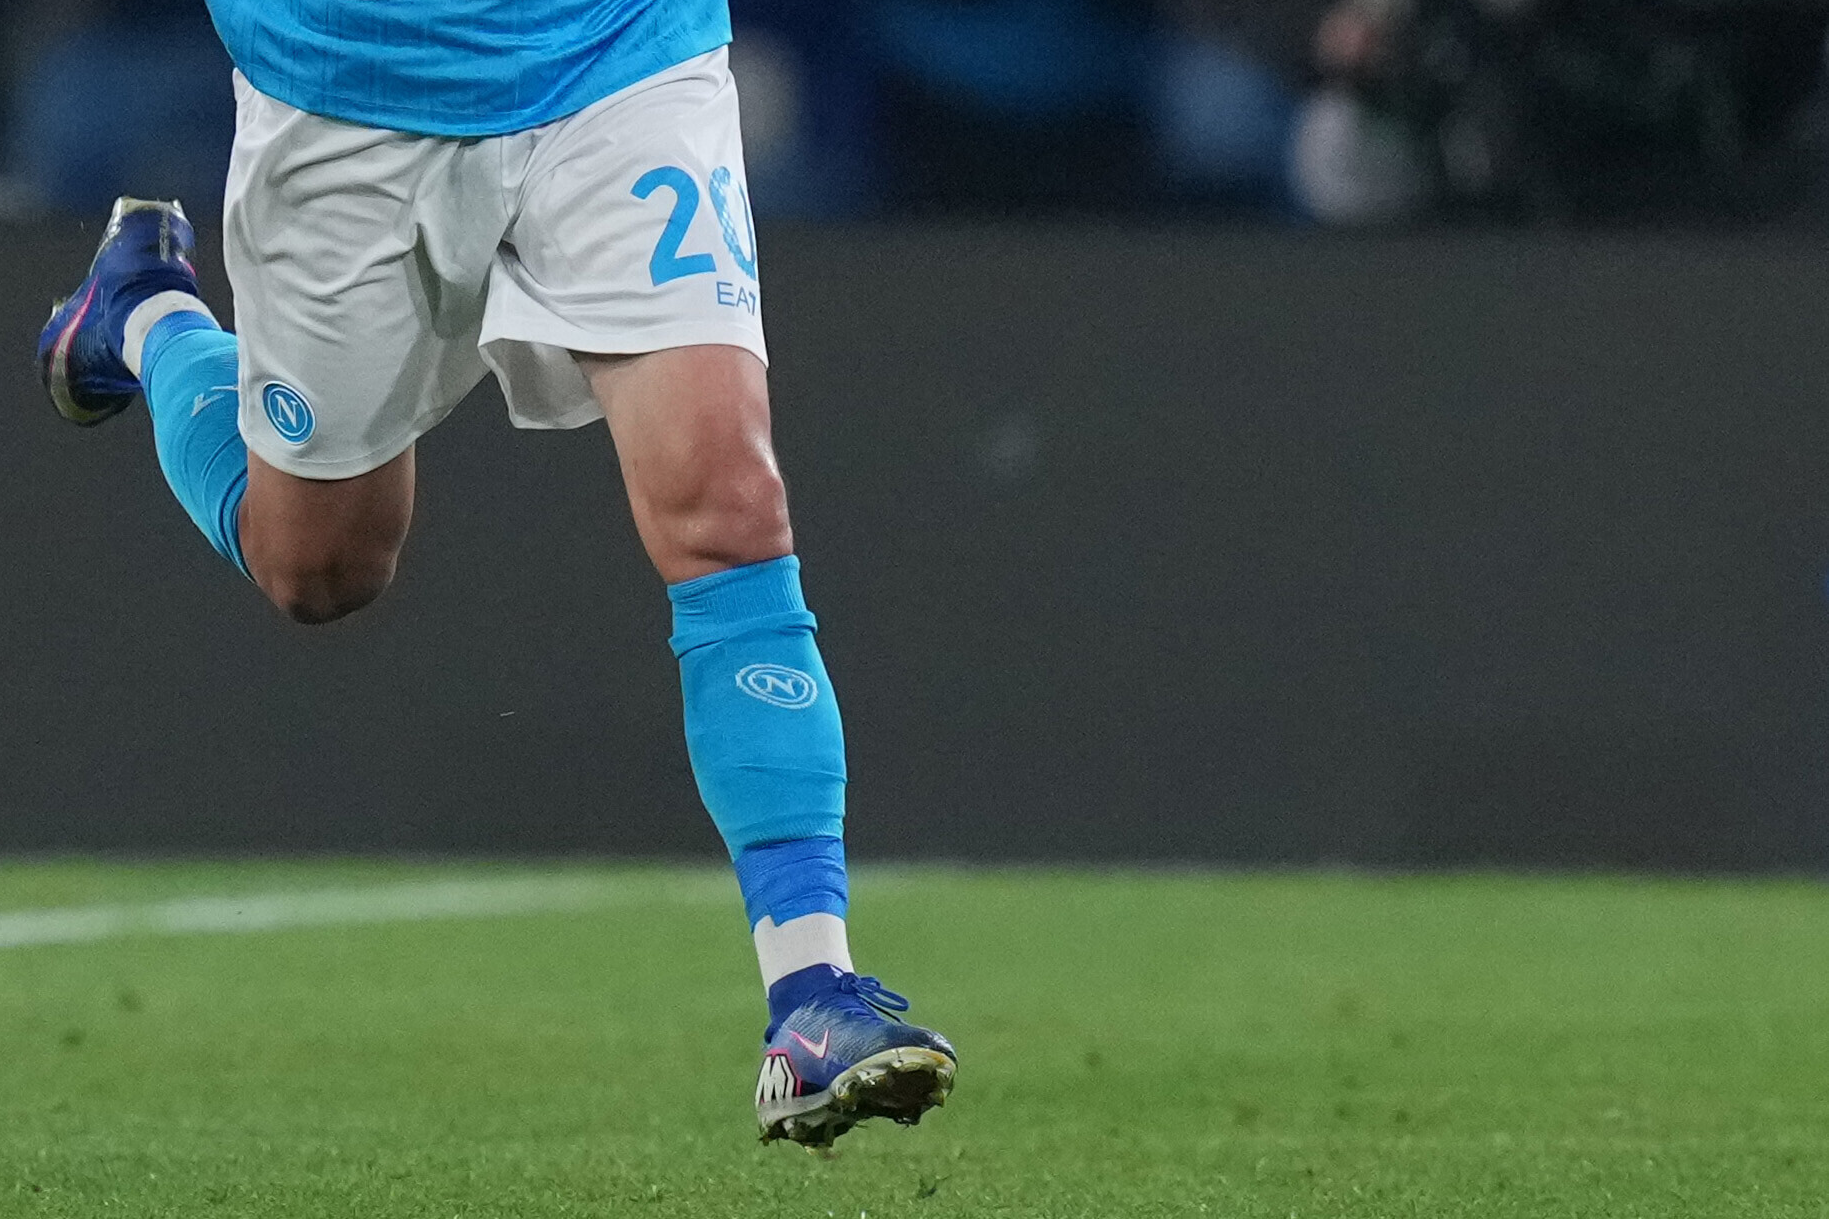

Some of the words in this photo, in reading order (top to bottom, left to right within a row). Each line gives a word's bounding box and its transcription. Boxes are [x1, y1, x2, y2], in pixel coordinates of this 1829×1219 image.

[629, 165, 758, 287] 20
[715, 281, 757, 317] EA7
[274, 393, 299, 429] N
